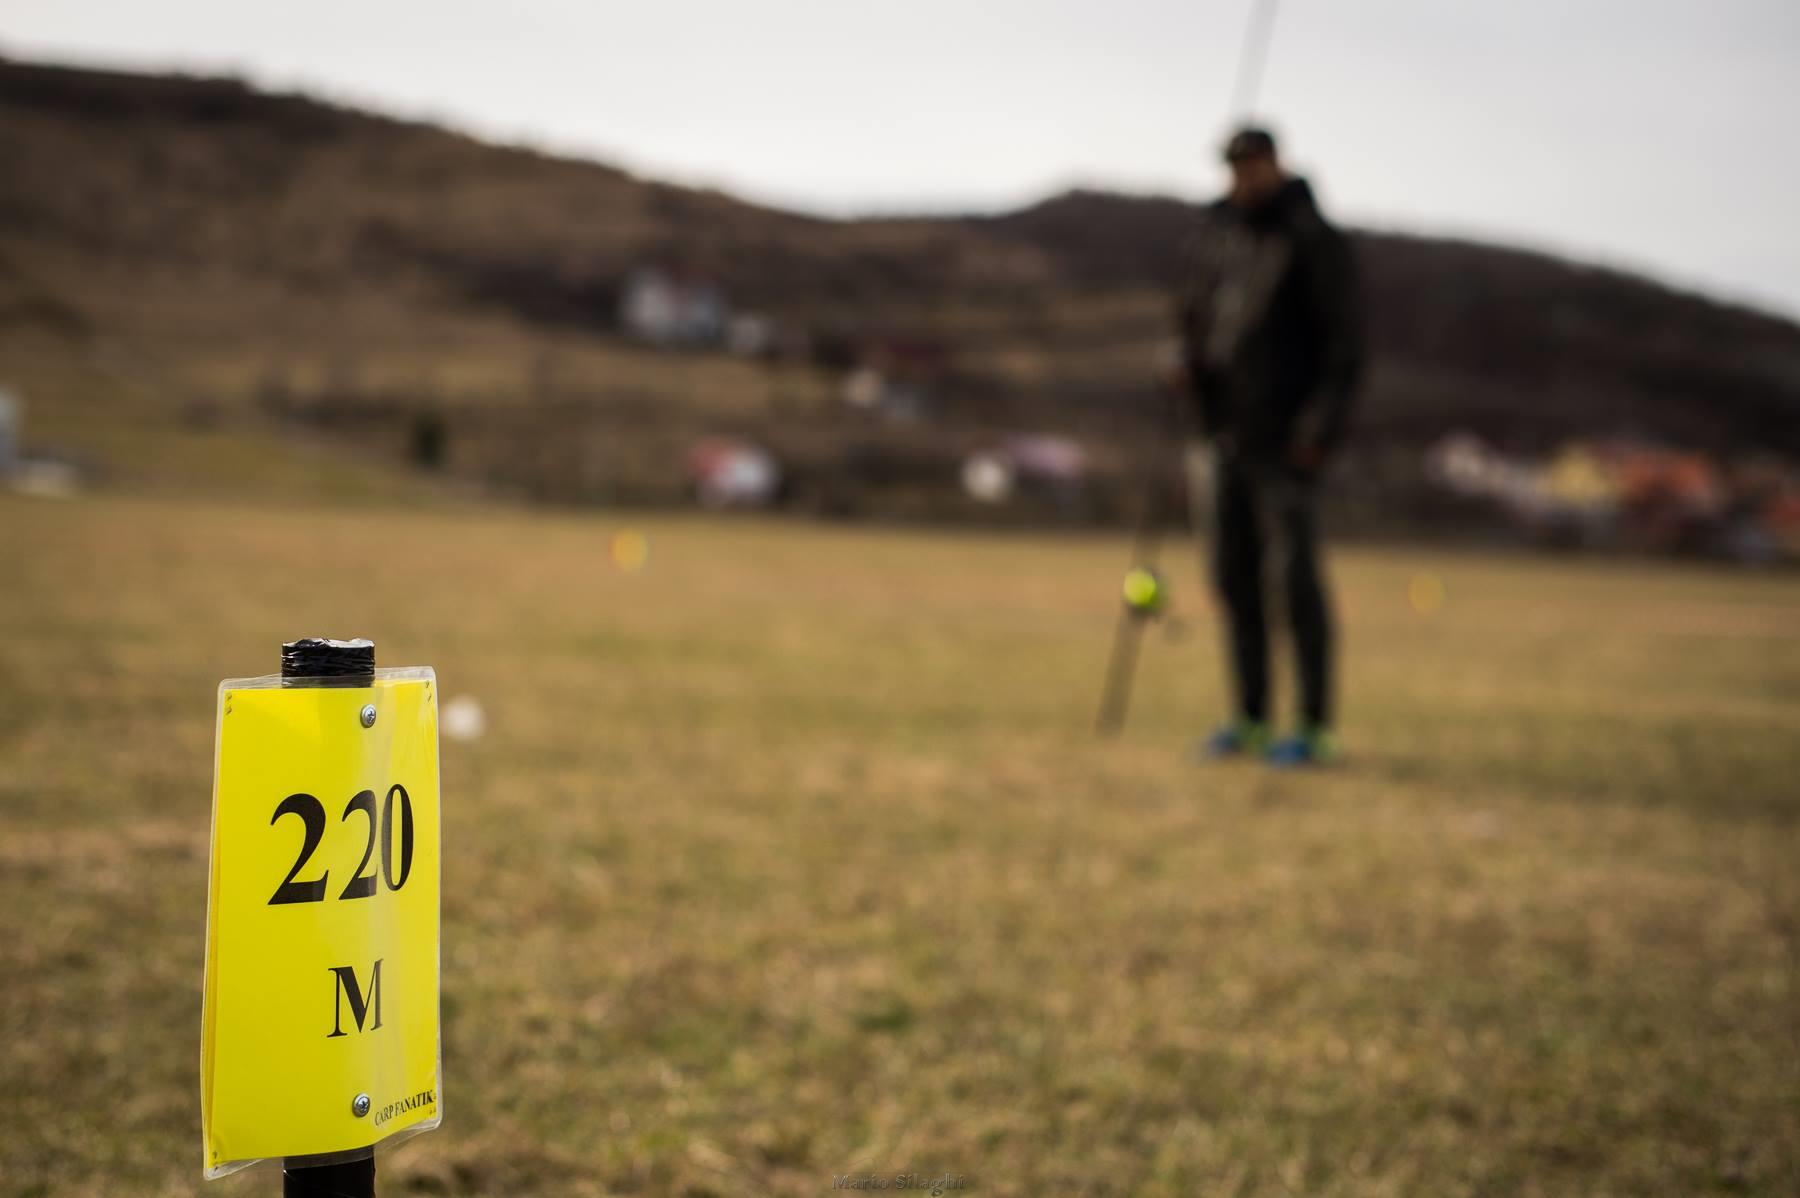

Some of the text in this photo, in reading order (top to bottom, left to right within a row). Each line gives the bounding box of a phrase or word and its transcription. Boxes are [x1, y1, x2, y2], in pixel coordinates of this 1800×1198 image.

[268, 783, 414, 905] 220
[327, 959, 384, 1038] M
[375, 1089, 434, 1126] CARP FANATIK
